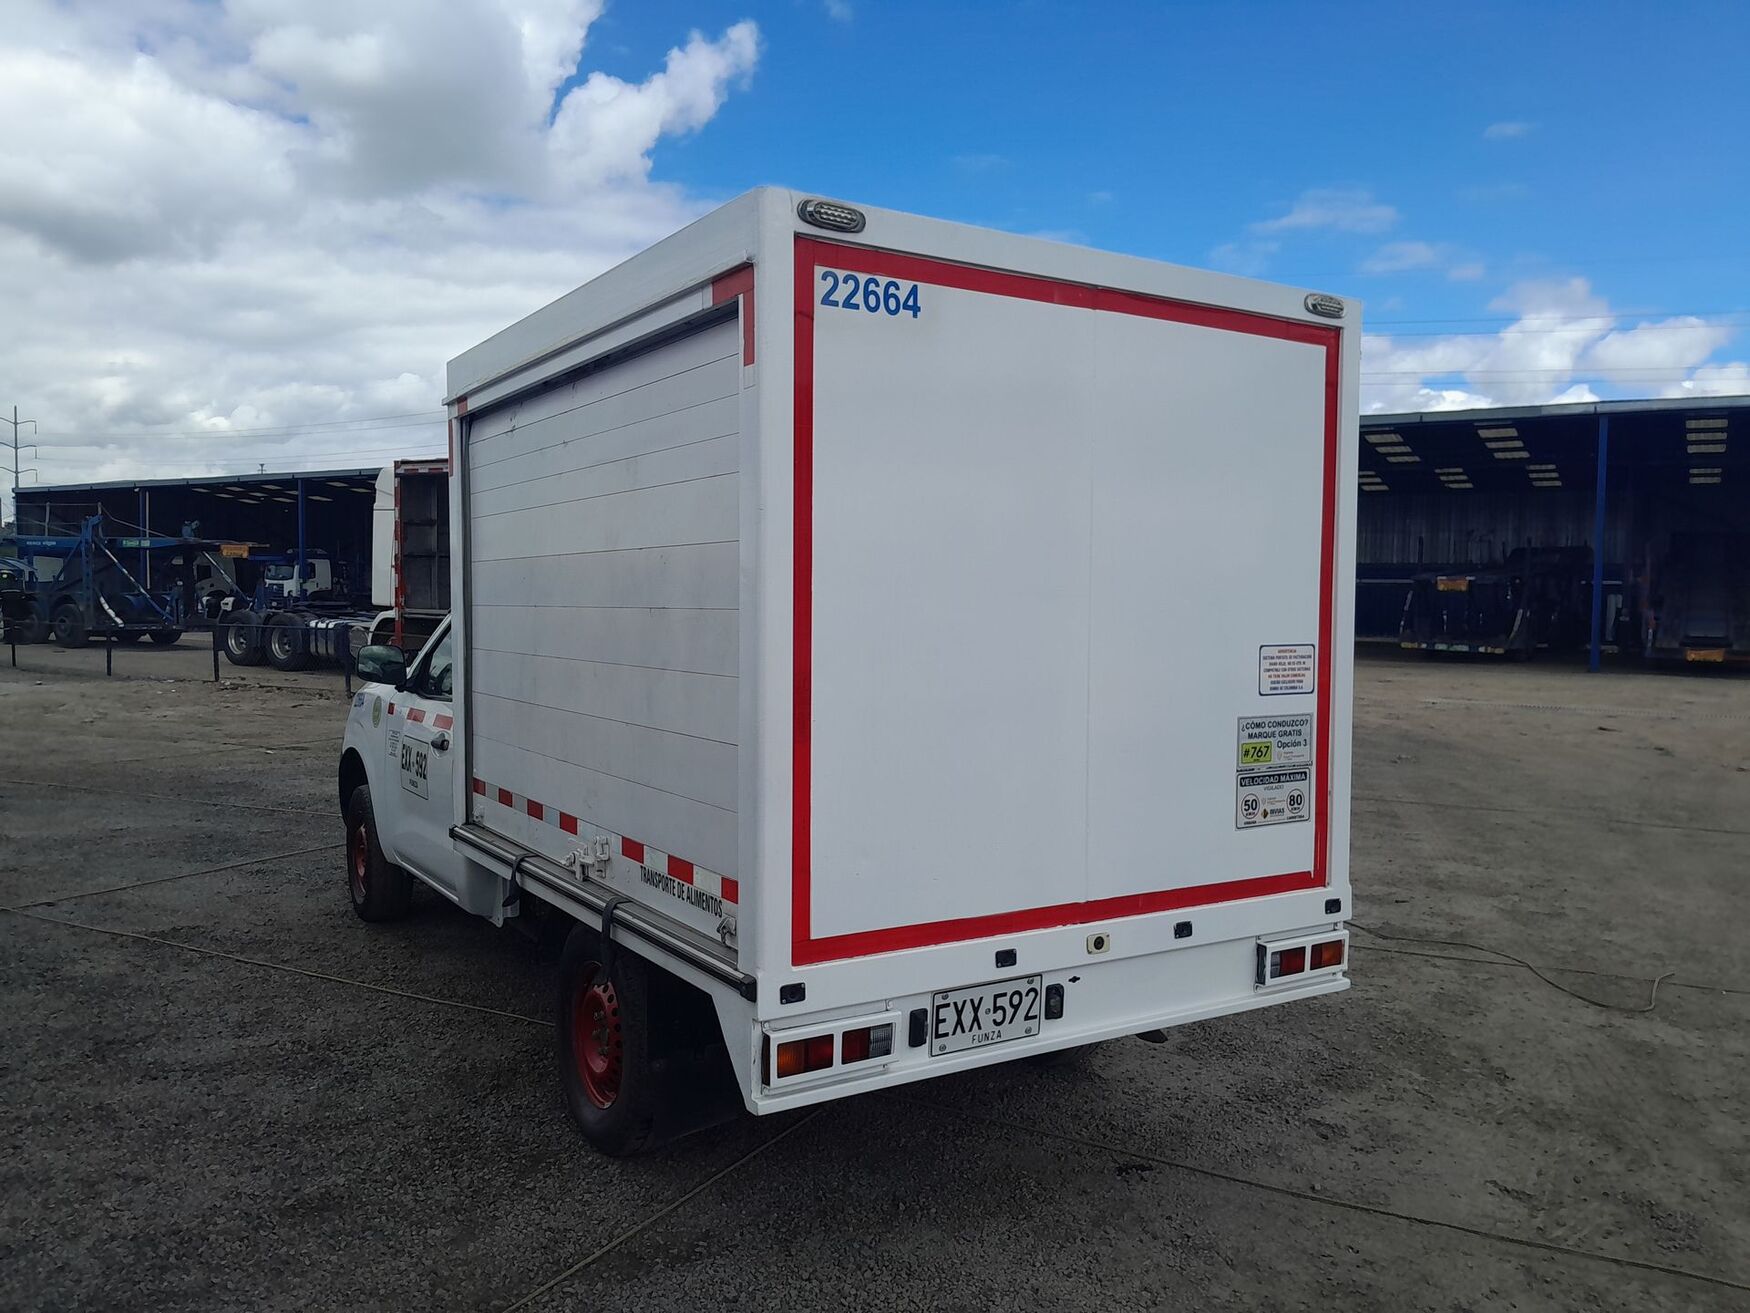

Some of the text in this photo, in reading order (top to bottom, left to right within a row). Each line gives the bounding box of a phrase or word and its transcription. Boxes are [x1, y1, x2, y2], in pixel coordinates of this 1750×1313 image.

[820, 270, 921, 318] 22664
[1241, 719, 1309, 732] ¿CÓMO CONDUZCO?
[1247, 728, 1302, 739] MARQUE GRATIS
[1277, 739, 1307, 749] Opción 3
[1243, 745, 1270, 759] #767
[1241, 772, 1306, 785] VELOCIDAD MÁXIMA
[1244, 799, 1257, 811] 50
[1289, 794, 1302, 806] 80
[639, 864, 724, 918] TRANSPORTE DE ALIMENTOS
[971, 1029, 1002, 1045] FUNZA
